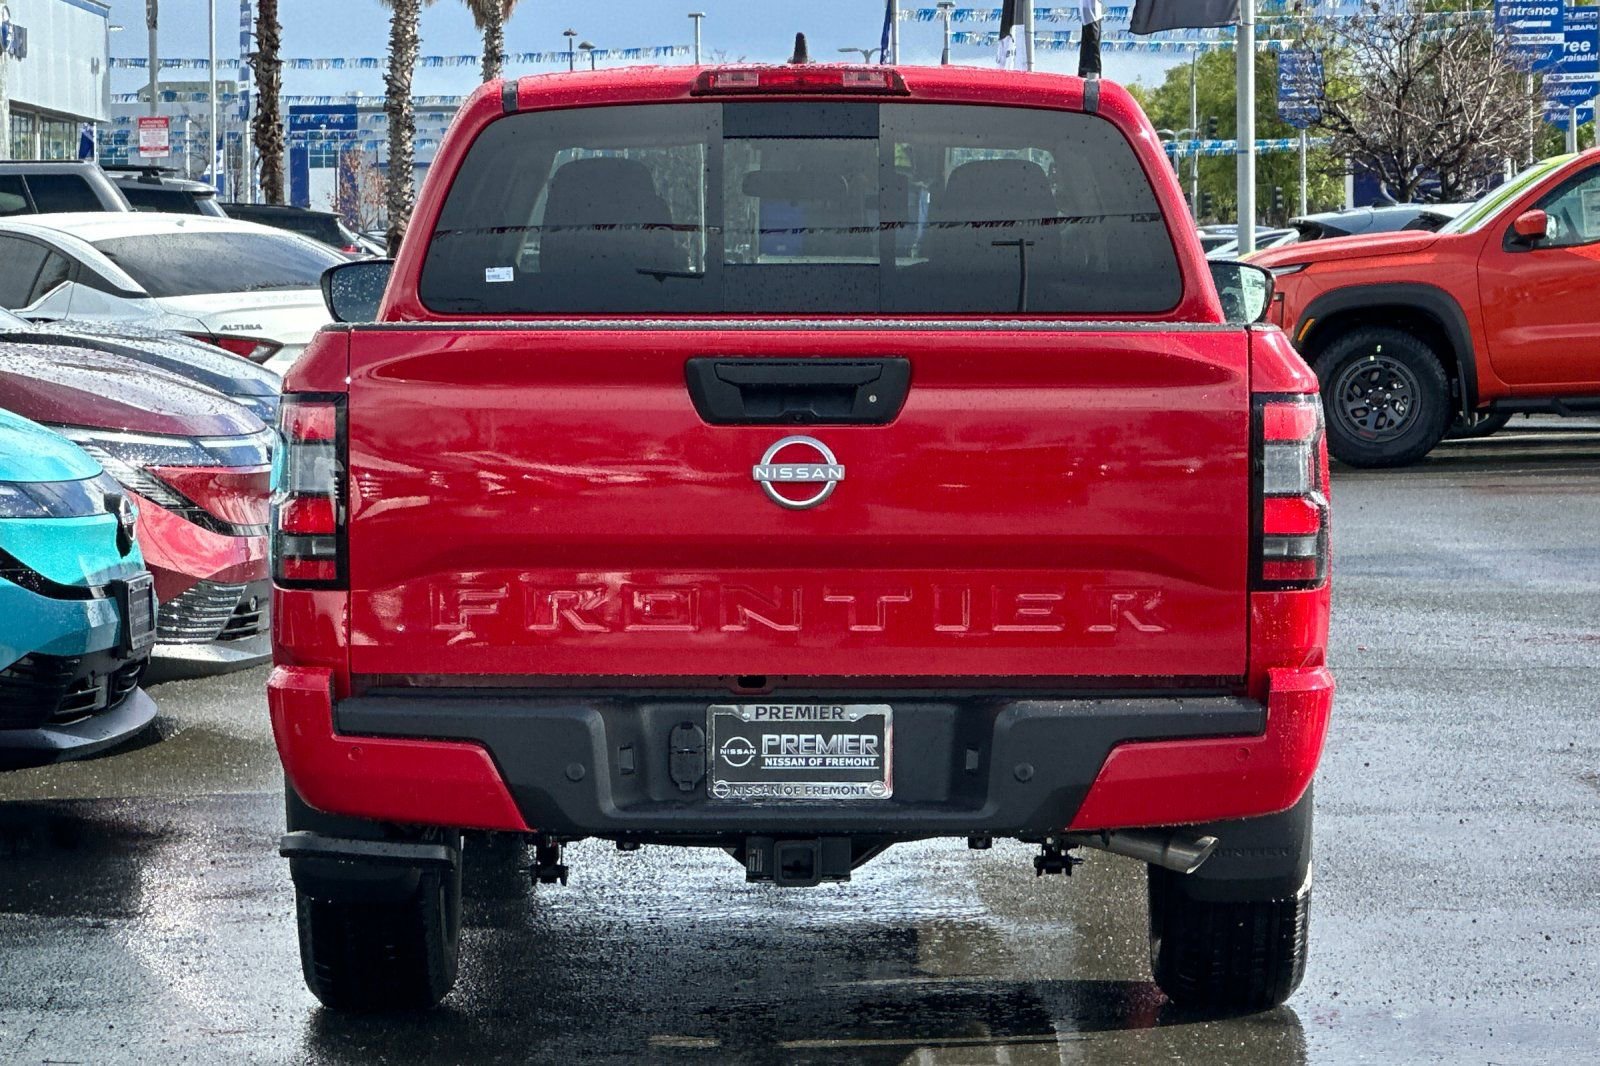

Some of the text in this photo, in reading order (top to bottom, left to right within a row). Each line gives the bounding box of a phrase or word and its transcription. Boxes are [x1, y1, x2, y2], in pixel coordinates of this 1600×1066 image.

[1499, 5, 1558, 17] Entrance
[1550, 86, 1593, 97] Welcome!
[220, 323, 263, 331] ALTIMA
[755, 467, 842, 479] NISSAN
[430, 581, 1167, 633] FRONTIER
[755, 706, 844, 720] PREMIER
[761, 734, 879, 755] PREMIER
[764, 757, 876, 767] NISSAN OF FREMONT
[732, 785, 783, 796] NISSAN
[784, 785, 800, 796] OF
[804, 785, 868, 796] FREMONT
